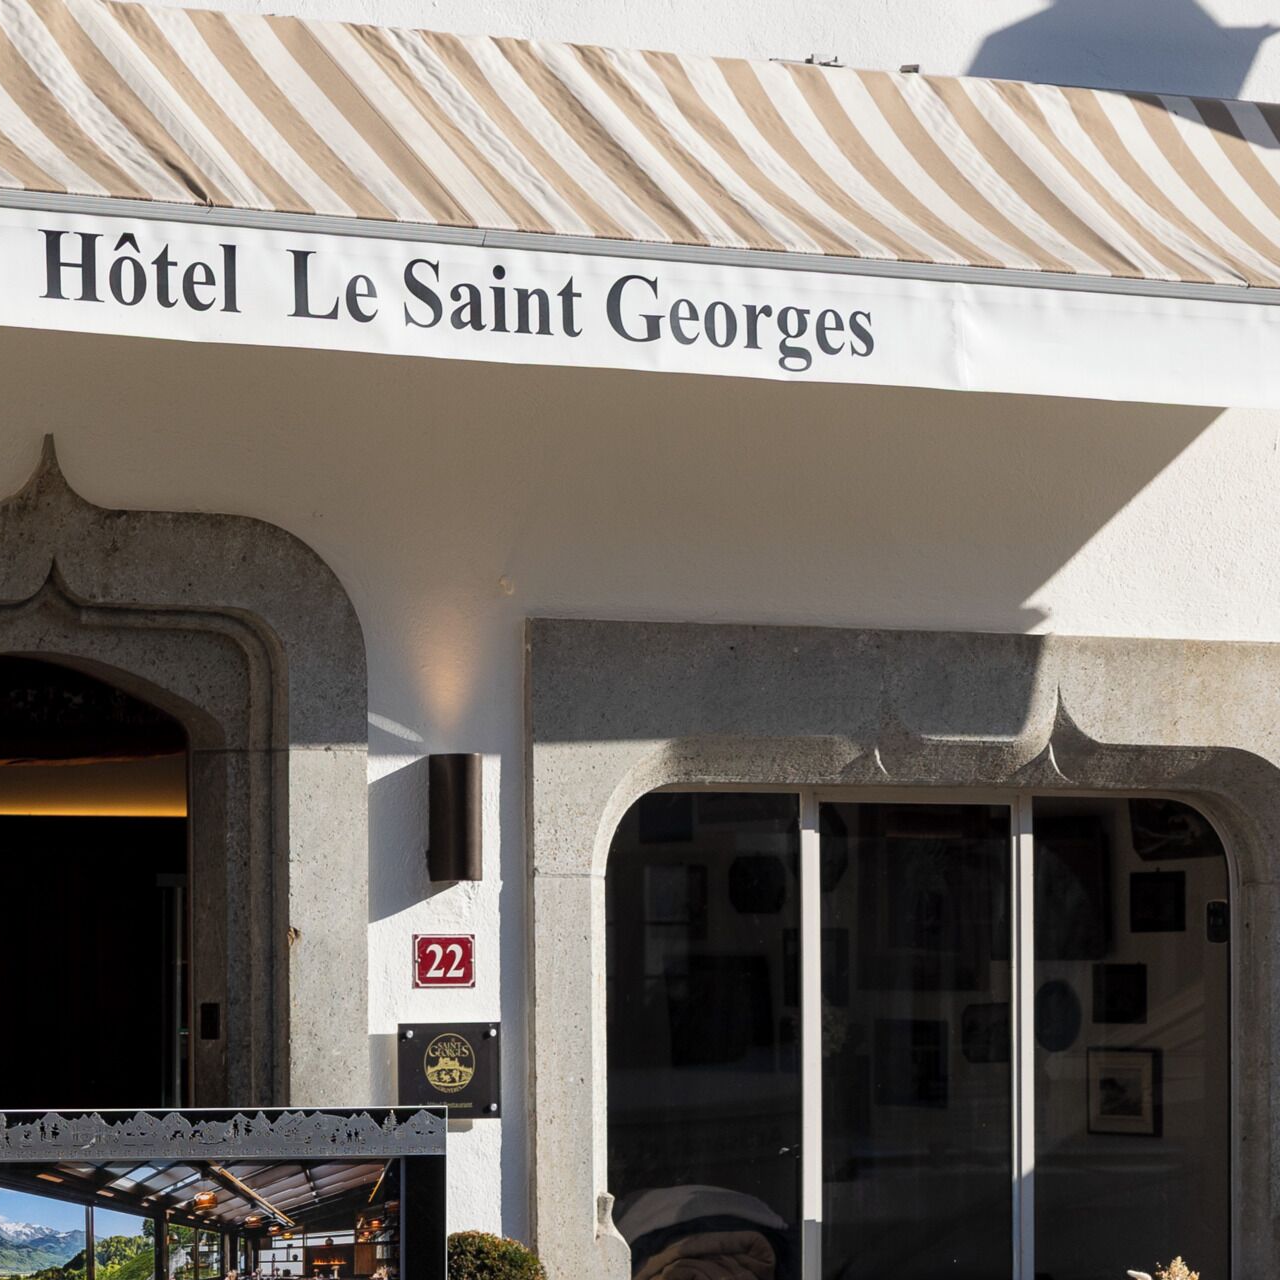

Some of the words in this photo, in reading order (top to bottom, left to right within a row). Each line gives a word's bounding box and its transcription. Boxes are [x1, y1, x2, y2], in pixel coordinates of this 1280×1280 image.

[37, 228, 242, 314] Hôtel
[287, 248, 379, 323] Le
[403, 258, 583, 338] Saint
[606, 273, 875, 372] Georges
[425, 943, 464, 978] 22
